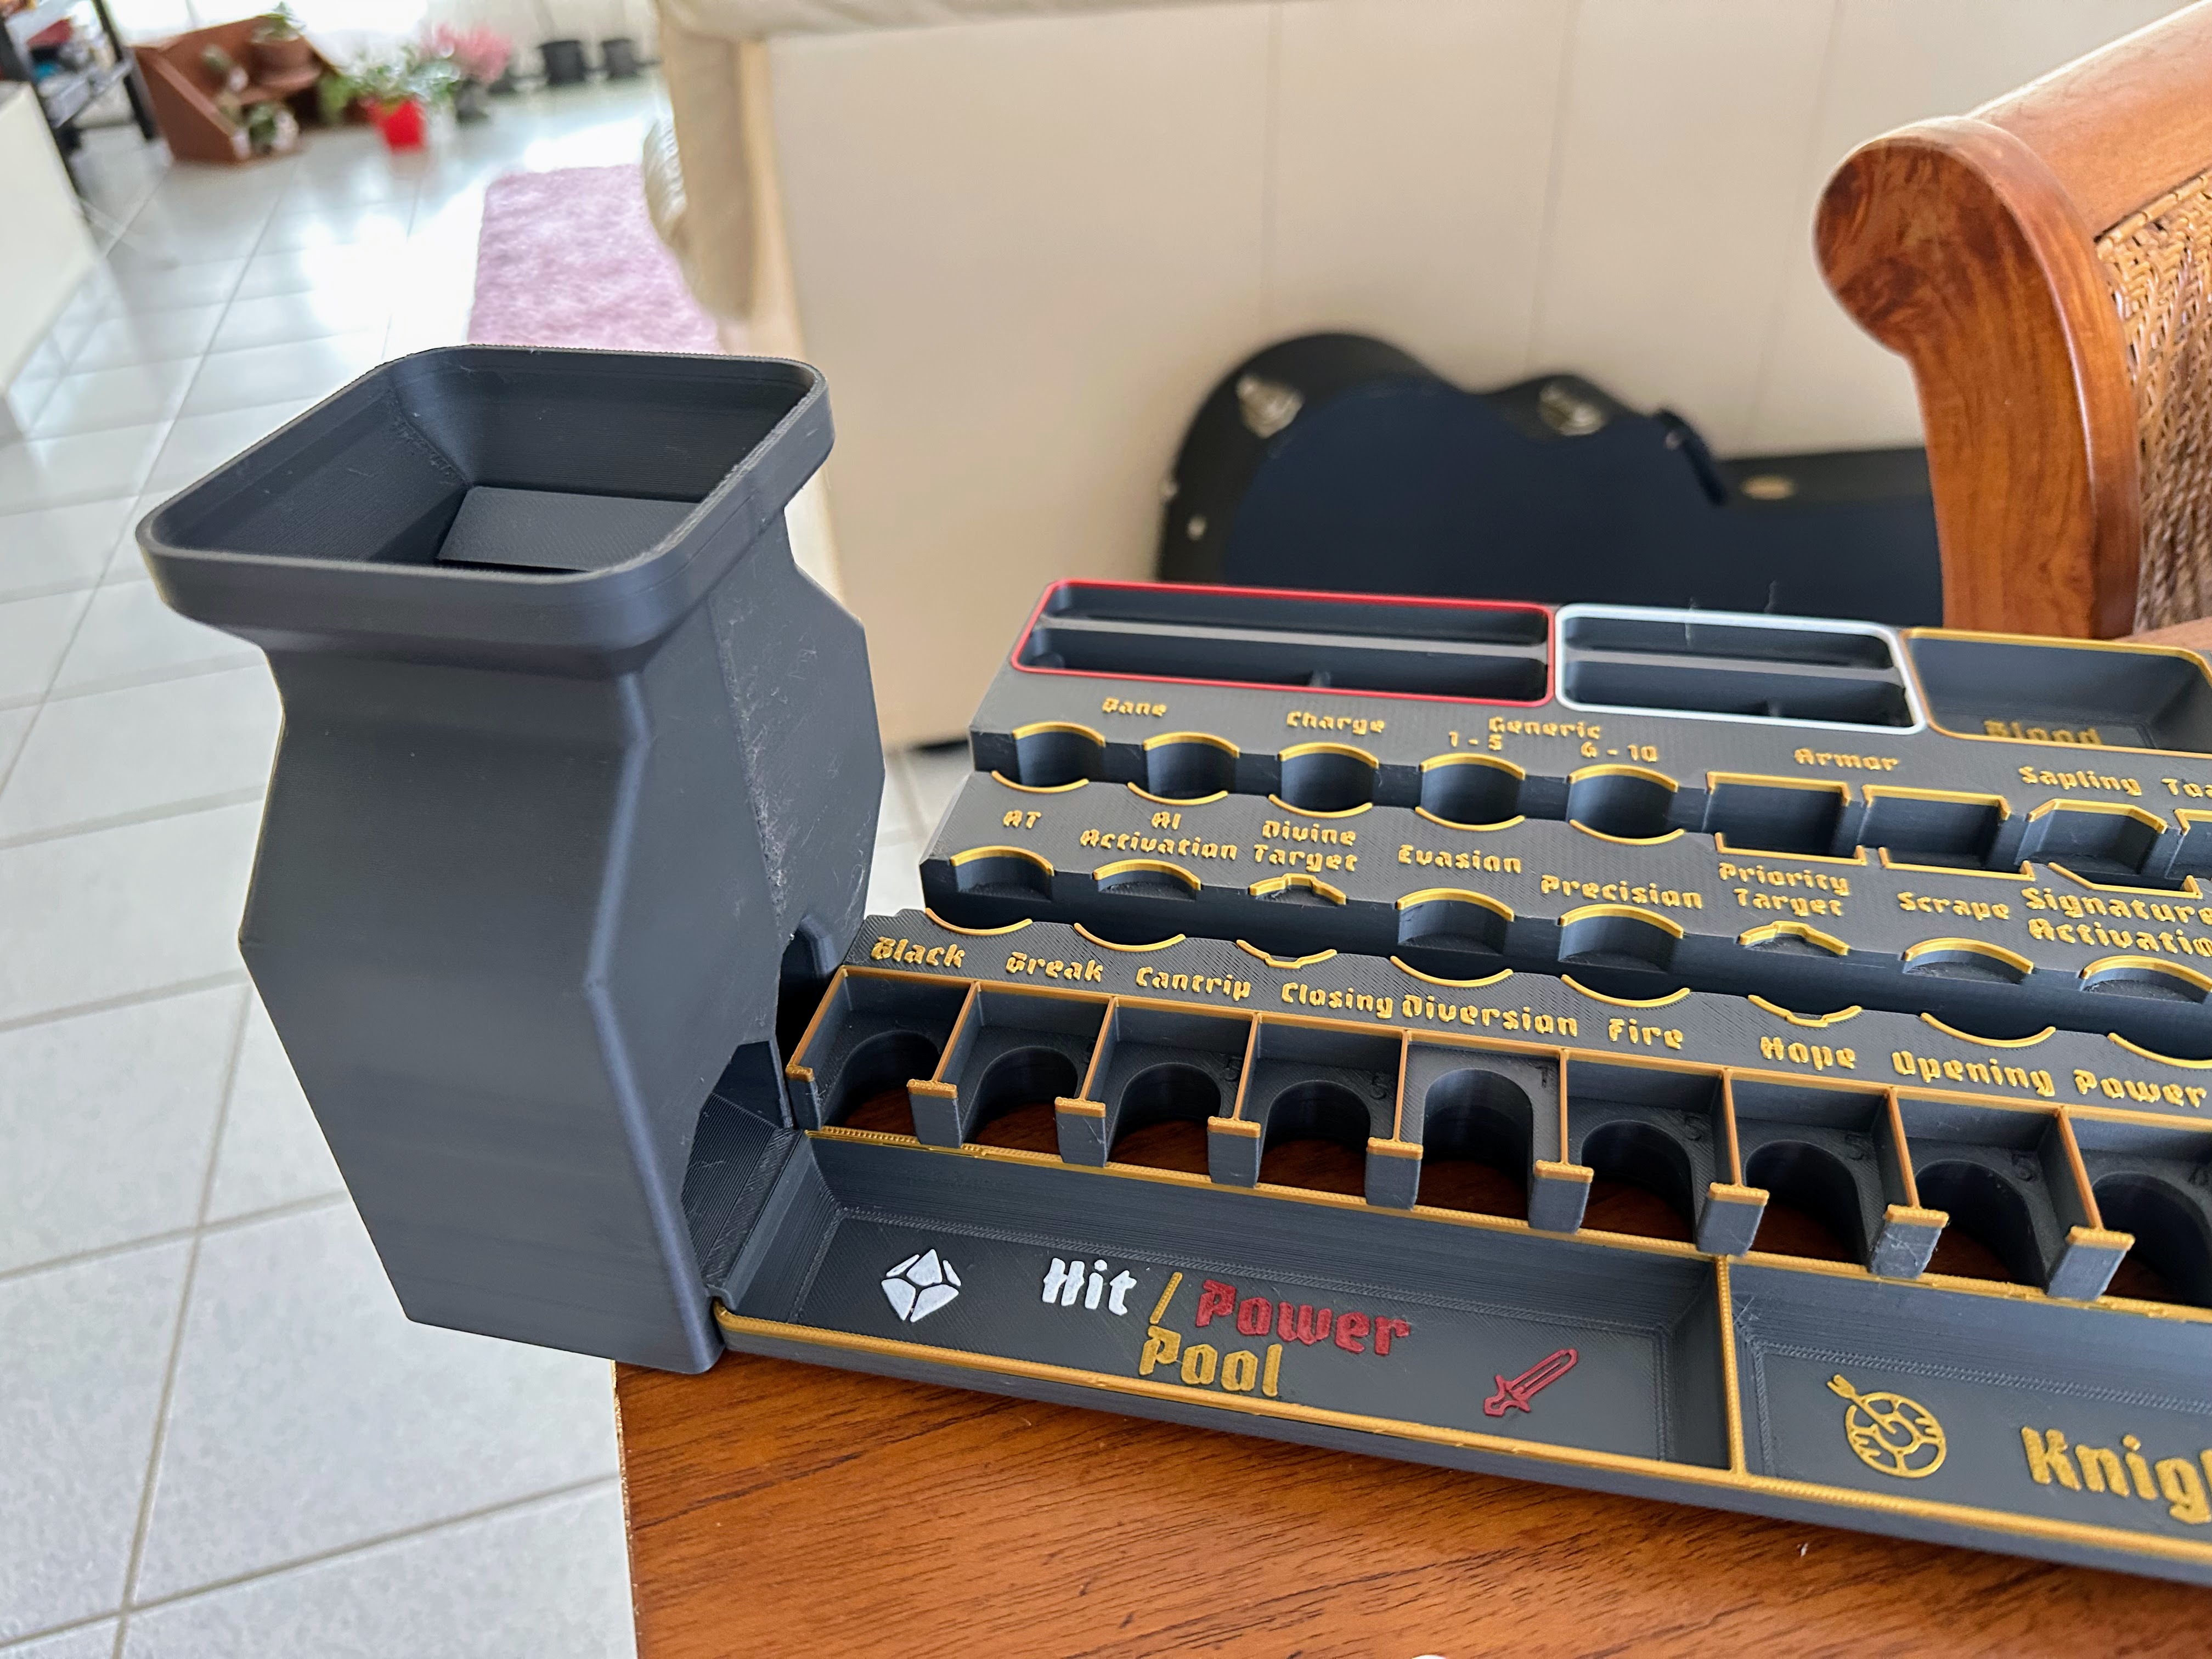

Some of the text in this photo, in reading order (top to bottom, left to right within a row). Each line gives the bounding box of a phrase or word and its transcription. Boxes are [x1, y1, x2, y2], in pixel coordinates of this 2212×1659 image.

[1102, 697, 1167, 716] Bane
[1286, 710, 1385, 736] Charge
[1488, 716, 1601, 740] Generic
[1449, 731, 1459, 747] 1
[1488, 734, 1502, 751] 5
[1628, 744, 1658, 763] 10
[1795, 748, 1899, 770] Armor
[2019, 766, 2142, 796] Sapling
[1080, 829, 1238, 860] Activation
[1262, 820, 1357, 846] Divine
[1254, 843, 1358, 872] Target
[1397, 844, 1522, 874] Evasion
[1541, 874, 1703, 909] Precision
[1719, 862, 1850, 896] Priority
[1734, 888, 1843, 917] Target
[1897, 891, 2010, 921] Scrape
[871, 936, 966, 968] Black
[1006, 952, 1103, 983] Break
[1136, 966, 1251, 1002] Cantrip
[1281, 981, 1393, 1019] Closing
[1402, 994, 1578, 1037] Diversion
[1608, 1018, 1684, 1049] Fire
[1760, 1036, 1857, 1071] Hope
[1892, 1051, 2056, 1097] Opening
[2073, 1069, 2207, 1108] Power
[1042, 1257, 1137, 1316] Hit
[1195, 1279, 1411, 1357] Power
[1138, 1324, 1283, 1398] Pool
